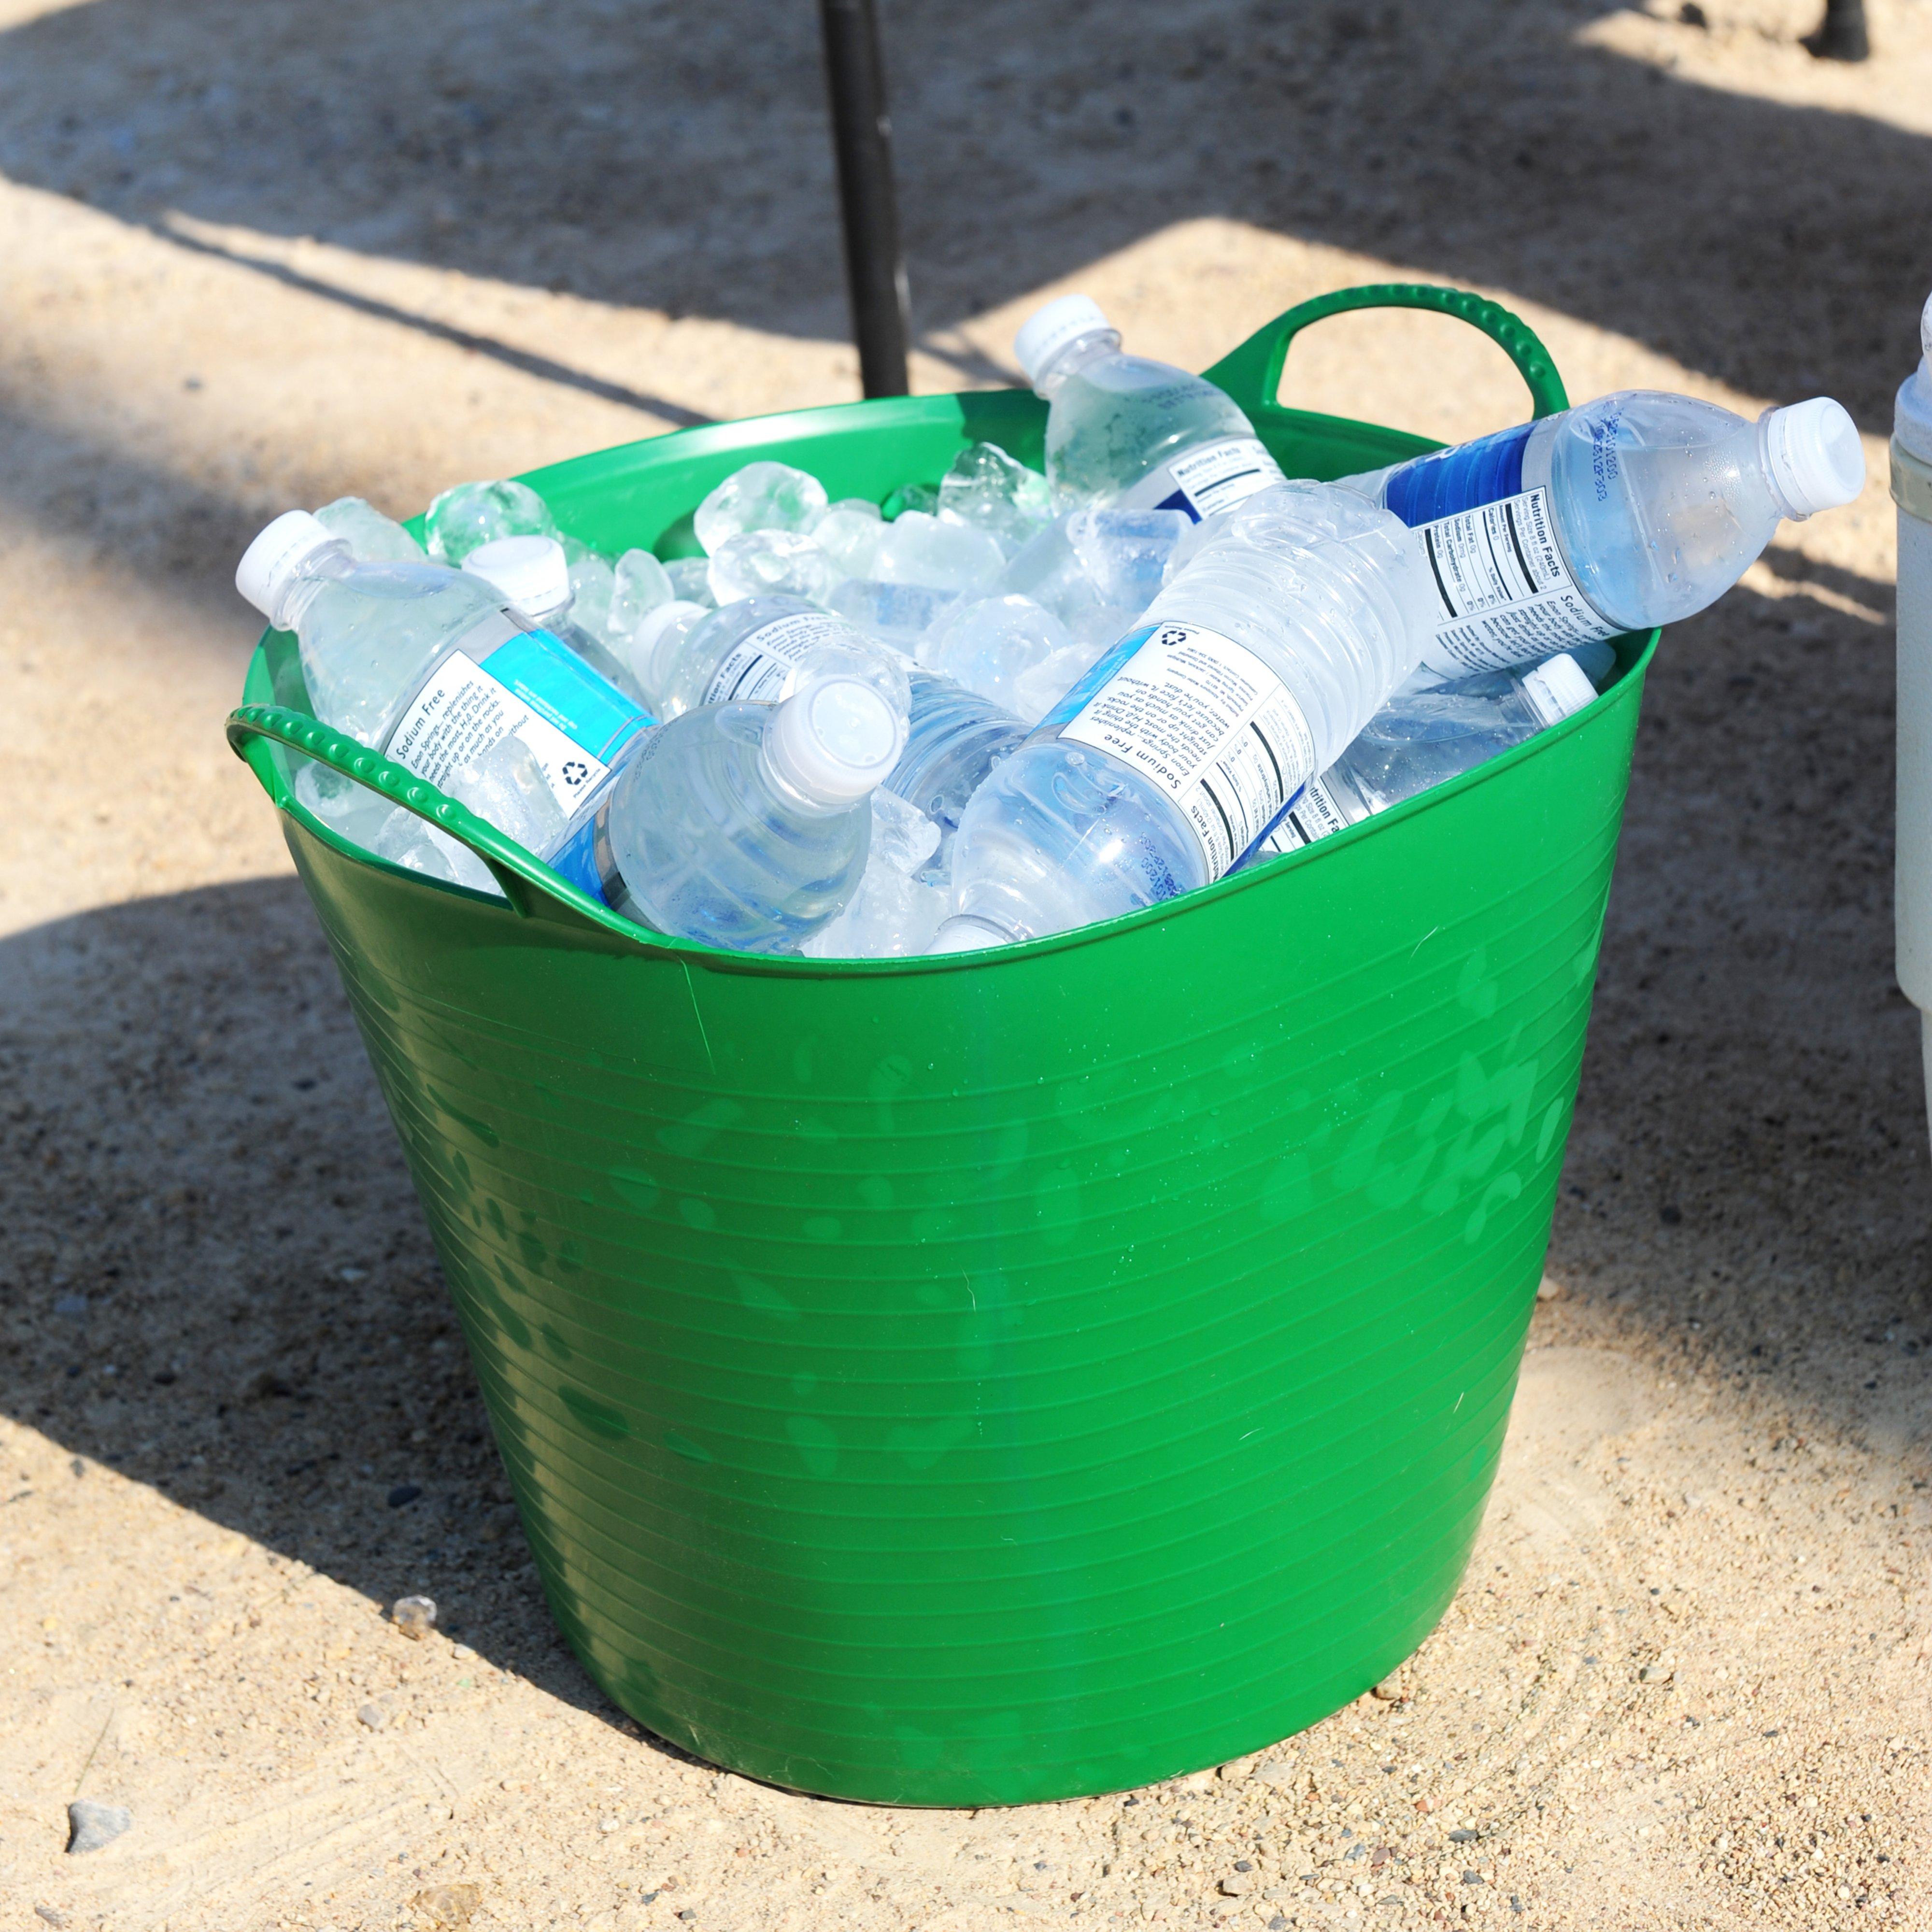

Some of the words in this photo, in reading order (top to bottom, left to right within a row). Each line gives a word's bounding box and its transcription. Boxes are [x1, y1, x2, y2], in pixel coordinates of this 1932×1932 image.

[1520, 495, 1530, 521] Serving
[1488, 507, 1497, 535] Calories
[1433, 524, 1441, 549] Protein
[1504, 533, 1512, 553] Serving
[1511, 498, 1522, 526] Servings
[1521, 538, 1535, 567] Container
[1532, 568, 1544, 585] about
[1530, 493, 1547, 544] Nutrition
[1542, 546, 1560, 577] Facts
[1436, 550, 1443, 558] 0g
[1453, 517, 1462, 542] Sodium
[1477, 597, 1485, 608] 0%
[1446, 539, 1462, 582] Carbohydrate
[1459, 583, 1465, 592] 0g
[1466, 600, 1475, 611] 0%
[1470, 544, 1476, 554] 0g
[1488, 594, 1495, 604] 0%
[1560, 595, 1592, 626] Sodium
[1117, 676, 1149, 687] without
[1164, 682, 1183, 693] dust.
[1107, 696, 1130, 706] rocks.
[1147, 694, 1173, 708] hands
[1159, 690, 1179, 701] face
[1183, 693, 1210, 709] you're
[1101, 703, 1125, 714] Drink
[1130, 704, 1144, 712] the
[1145, 701, 1168, 714] much
[1172, 707, 1193, 719] your
[1178, 699, 1195, 711] let's
[396, 717, 425, 760] Sodium
[421, 689, 445, 716] Free
[410, 750, 424, 769] Enon
[442, 681, 473, 720] replenishes
[1101, 710, 1123, 722] thing
[1124, 720, 1139, 729] the
[1191, 718, 1207, 728] get
[1195, 710, 1224, 736] because
[1208, 708, 1229, 728] water,
[495, 726, 503, 737] on
[1089, 716, 1136, 736] replenishes
[1139, 727, 1158, 739] with
[1144, 719, 1166, 733] most,
[1178, 720, 1199, 735] drink
[1205, 729, 1218, 741] can
[420, 758, 430, 779] your
[427, 740, 442, 760] body
[440, 724, 453, 741] with
[451, 710, 462, 724] the
[460, 692, 479, 711] thing
[428, 761, 441, 785] needs
[439, 749, 449, 762] the
[447, 729, 463, 750] most,
[471, 693, 490, 714] Drink
[436, 761, 453, 789] straight
[451, 752, 459, 763] up
[458, 741, 465, 752] or
[465, 731, 473, 742] on
[471, 718, 483, 732] the
[482, 700, 500, 719] rocks.
[463, 753, 470, 764] as
[469, 732, 485, 754] much
[484, 724, 492, 733] as
[491, 710, 504, 726] you
[1104, 734, 1133, 753] Free
[1166, 733, 1180, 743] the
[1179, 731, 1207, 755] straight
[1198, 736, 1216, 749] Just
[1137, 735, 1171, 759] Springs...
[1158, 738, 1179, 753] body
[1180, 743, 1201, 762] needs
[1136, 750, 1181, 789] Sodium
[1171, 758, 1190, 776] Enon
[1178, 754, 1197, 768] your
[1257, 763, 1271, 804] Carbohydrate
[1305, 802, 1315, 814] Size
[1191, 805, 1209, 838] Facts
[1285, 821, 1296, 838] Serving
[1208, 836, 1221, 881] Nutrition
